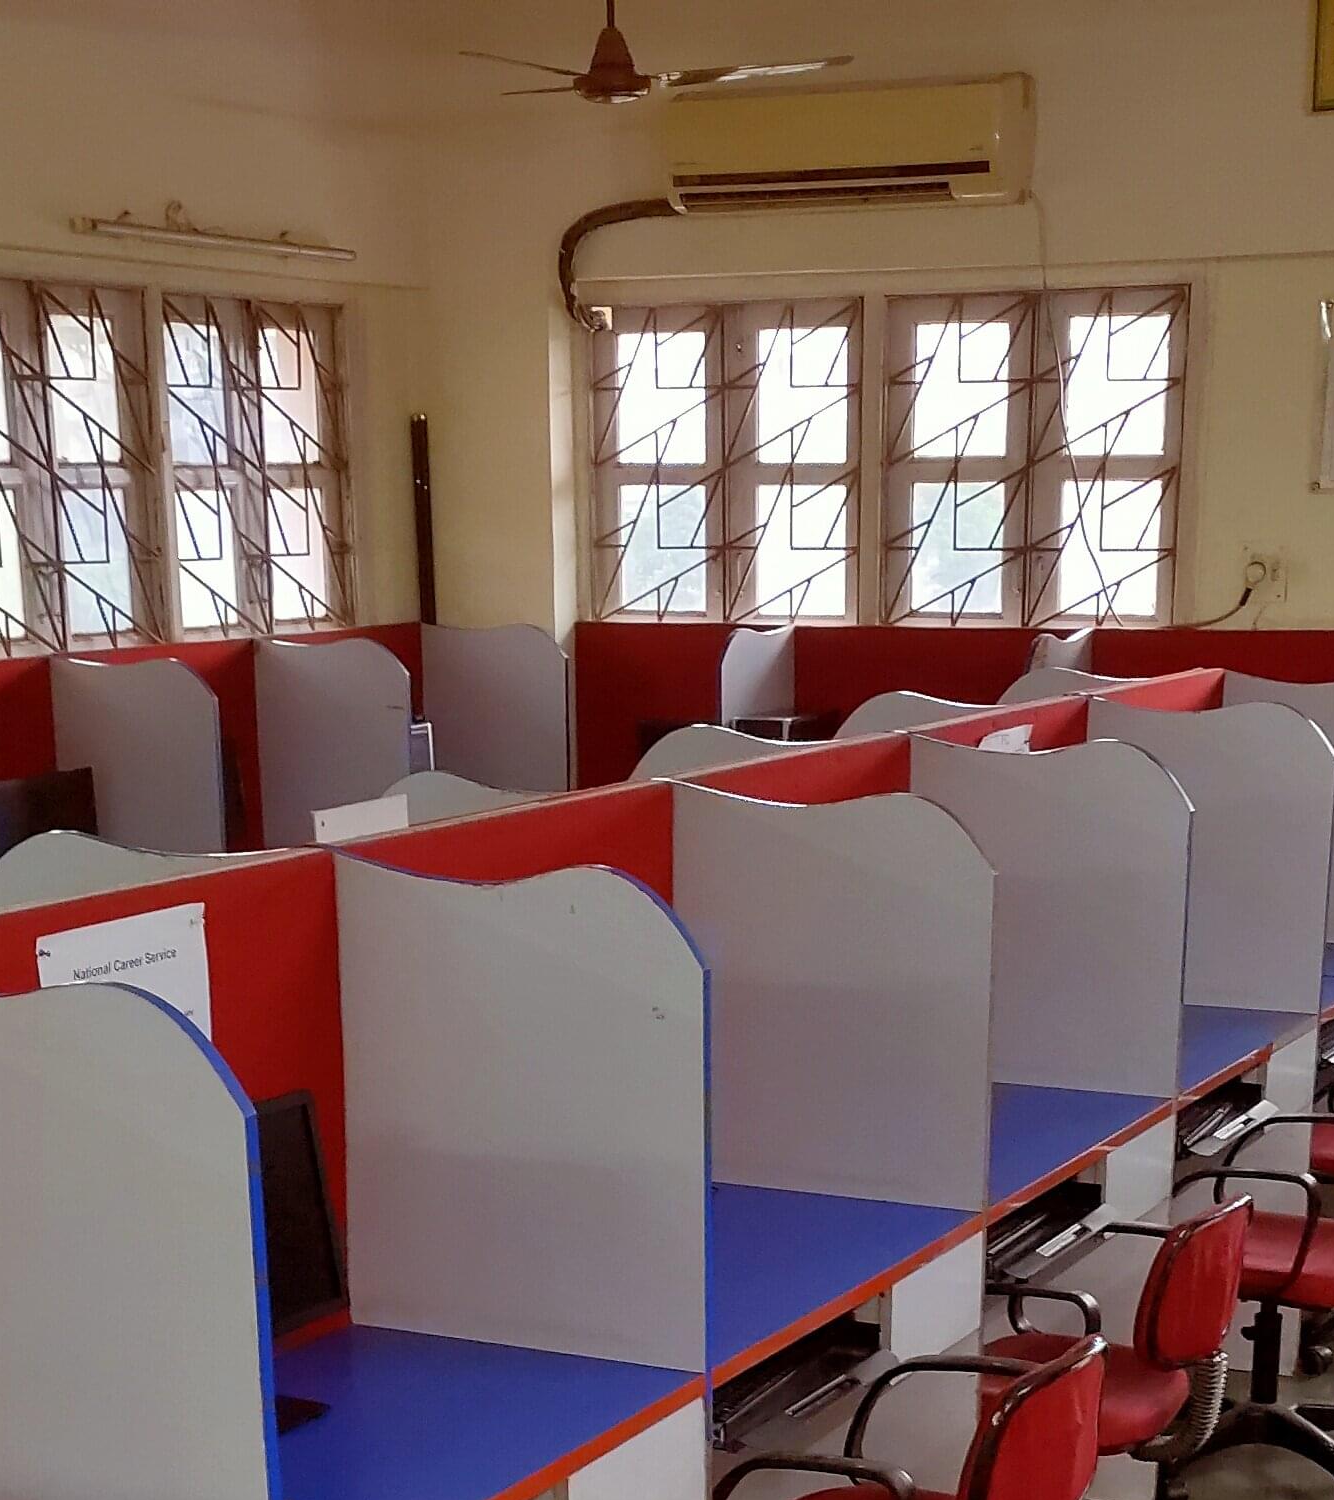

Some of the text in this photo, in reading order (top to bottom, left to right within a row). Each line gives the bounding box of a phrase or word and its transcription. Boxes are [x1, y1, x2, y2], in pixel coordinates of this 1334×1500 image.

[73, 948, 177, 981] National Career Service
